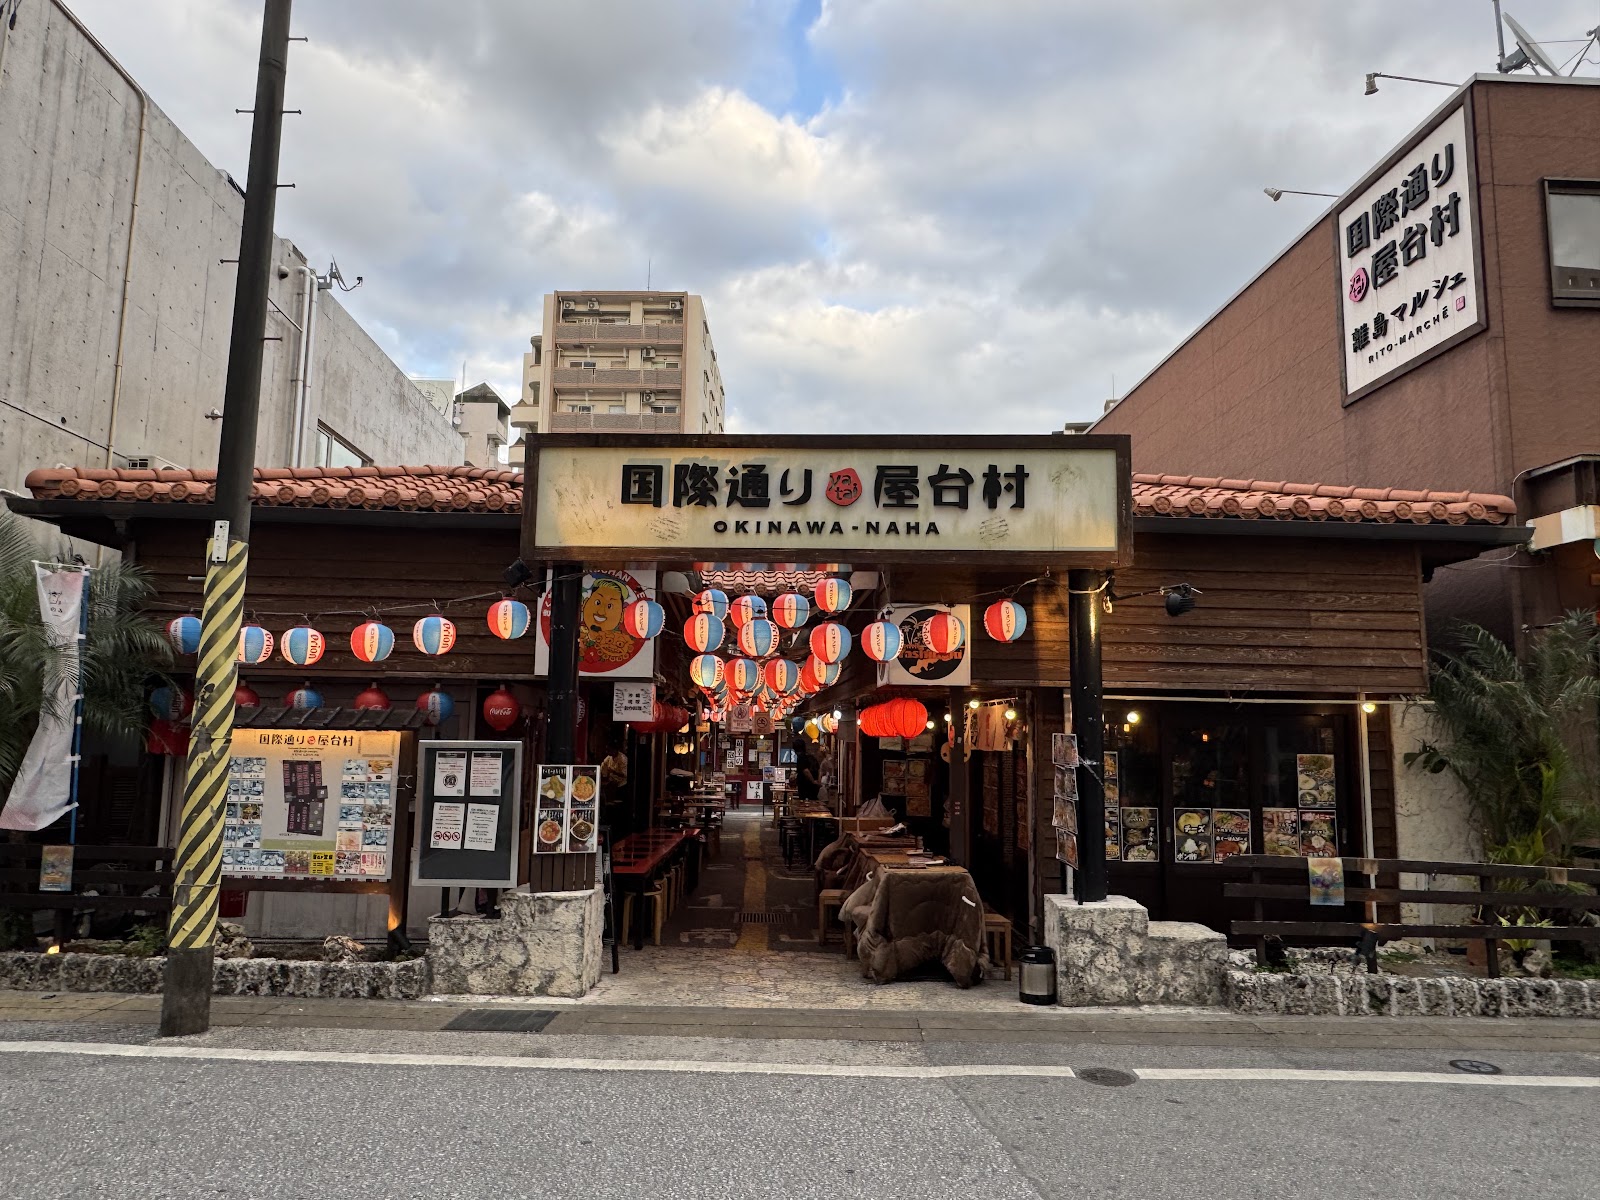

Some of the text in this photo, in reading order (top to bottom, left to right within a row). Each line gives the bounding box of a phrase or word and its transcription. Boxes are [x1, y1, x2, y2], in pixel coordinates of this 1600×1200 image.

[1346, 143, 1455, 258] 国際通り
[1370, 191, 1461, 290] 屋台村
[1351, 272, 1466, 353] 離島マルシェ
[621, 462, 1030, 509] 国際通り 屋台村
[713, 520, 940, 535] OKINAWA-NAHA
[259, 733, 354, 747] 国際通り 屋台村
[1183, 824, 1206, 833] チーズ
